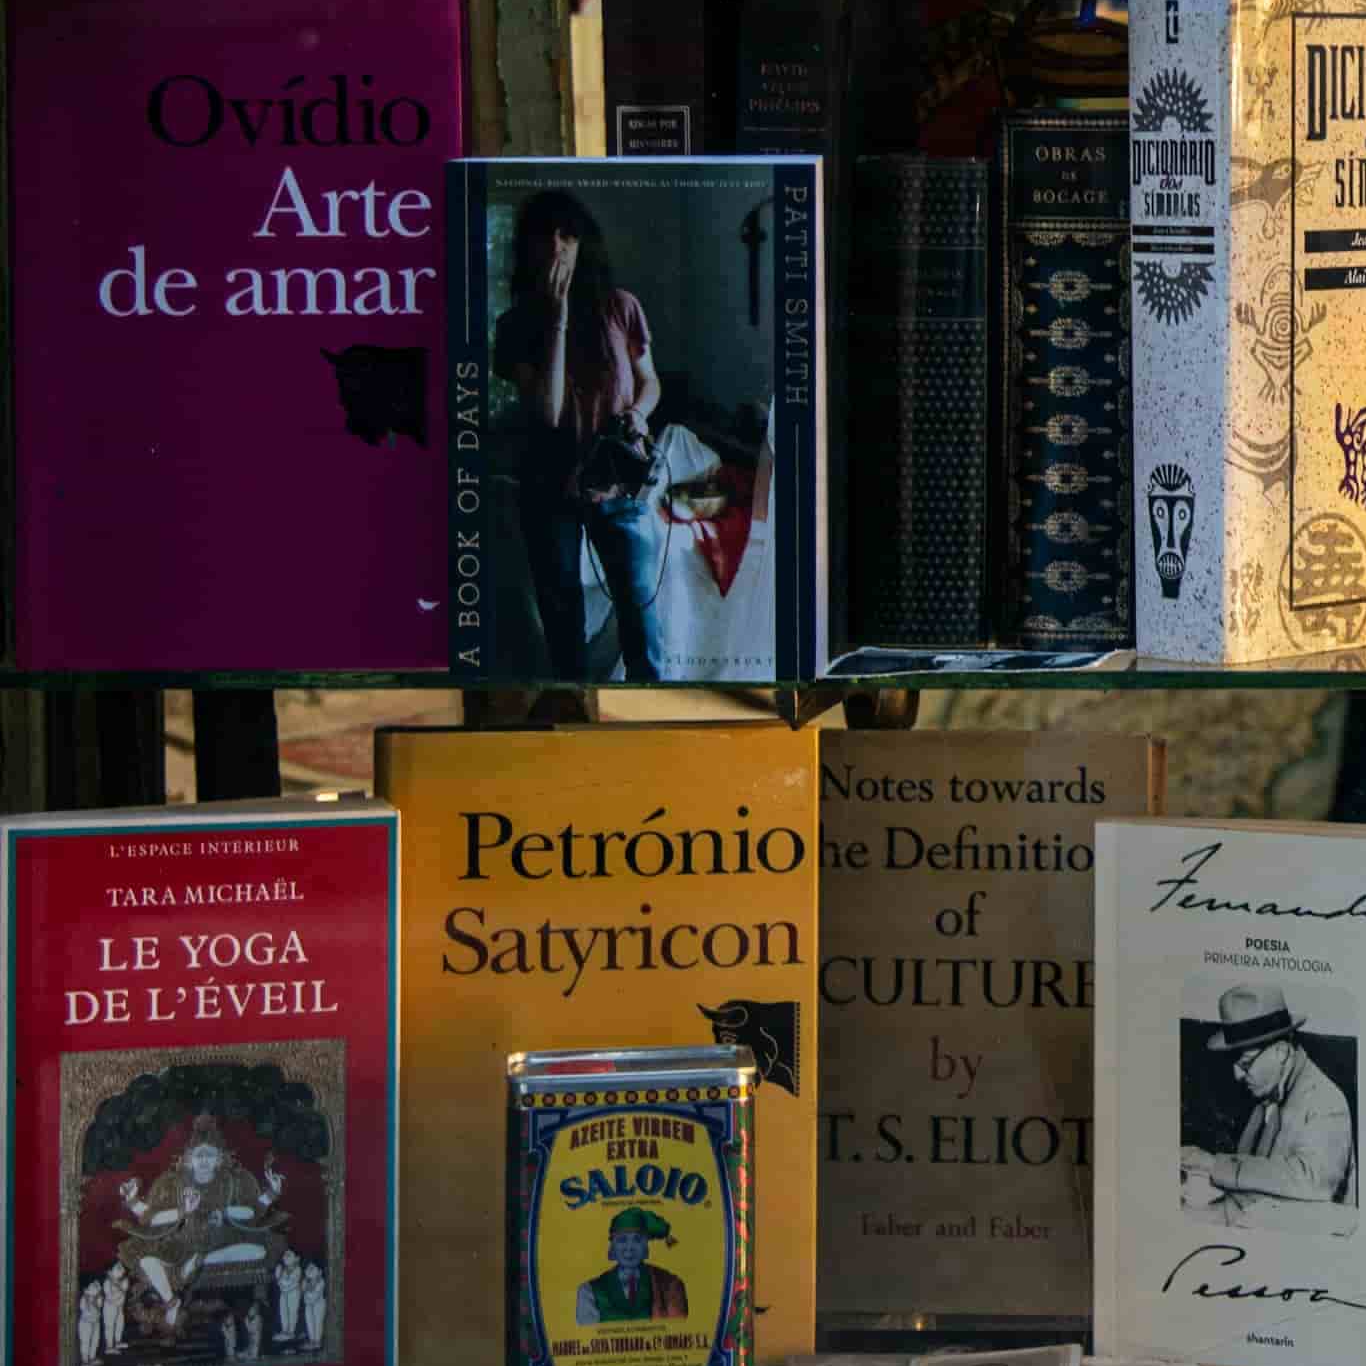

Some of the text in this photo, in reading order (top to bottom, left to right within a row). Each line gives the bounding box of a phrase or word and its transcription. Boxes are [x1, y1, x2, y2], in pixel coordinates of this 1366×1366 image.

[147, 72, 432, 150] Ovídio
[1033, 145, 1108, 165] OBRAS
[251, 163, 433, 239] Arte
[97, 244, 439, 320] de amar
[782, 184, 810, 407] PATTI SMITH
[455, 359, 482, 456] DAYS
[456, 466, 482, 516] OF
[456, 528, 482, 630] BOOK
[820, 764, 1107, 807] Notes towards
[456, 802, 807, 884] Petrónio
[105, 878, 305, 910] TARA MICHAËL
[934, 891, 985, 938] of
[98, 927, 309, 975] LE YOGA
[440, 901, 808, 998] Satyricon
[1203, 949, 1334, 975] PRIMEIRA ANTOLOGIA
[1244, 936, 1291, 954] POESIA
[64, 971, 340, 1029] DE L'ÉVEIL
[820, 956, 1094, 1009] CULTURE
[927, 1035, 984, 1101] by
[568, 1115, 696, 1151] AZEITE VIRGEM
[820, 1114, 1094, 1163] T. S. ELIOT
[559, 1162, 709, 1210] SALOIO
